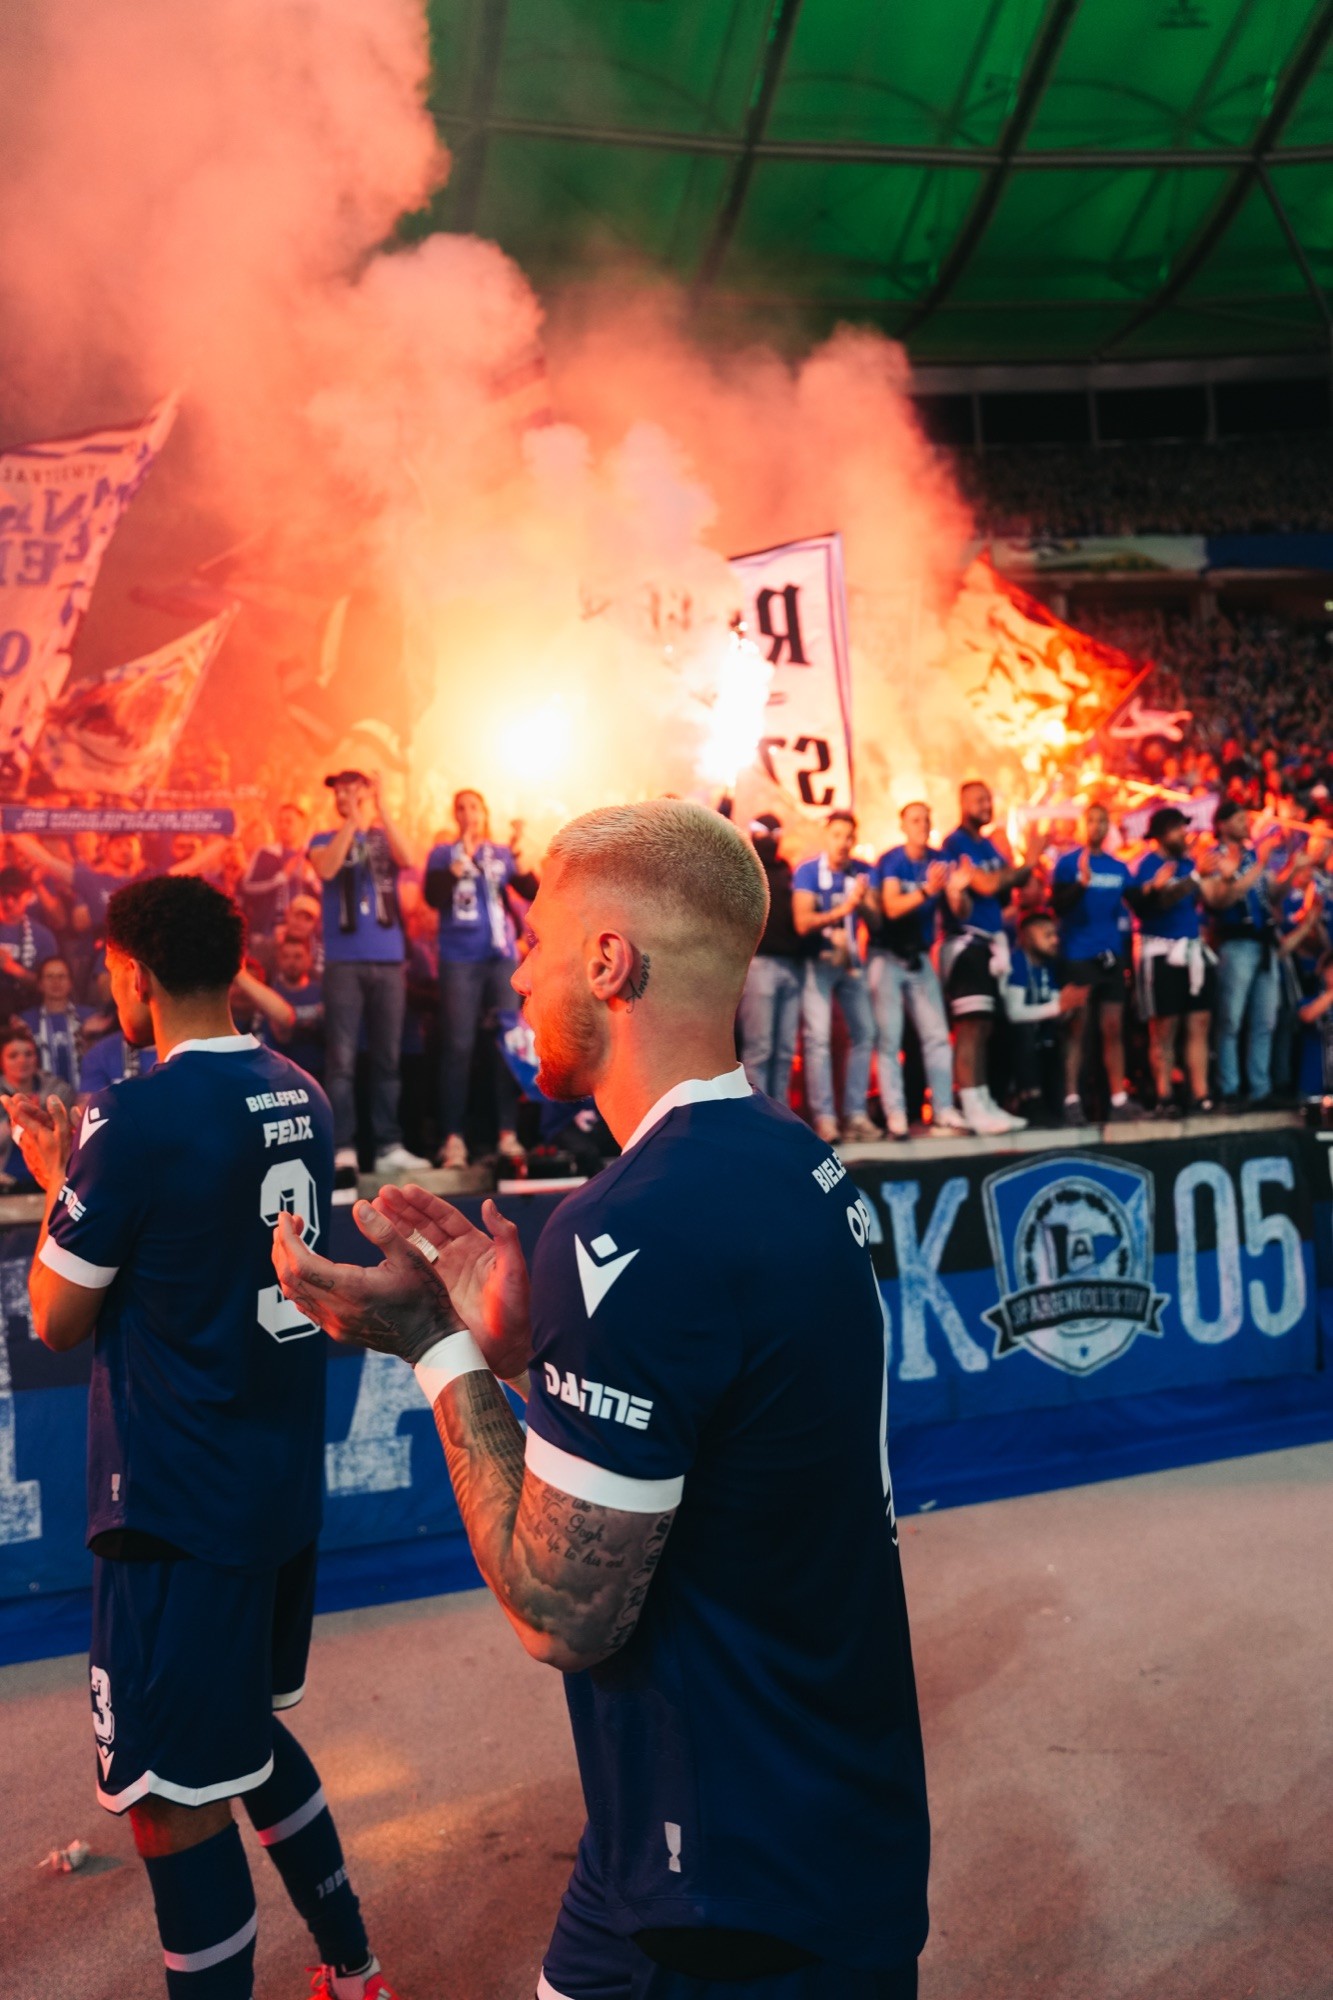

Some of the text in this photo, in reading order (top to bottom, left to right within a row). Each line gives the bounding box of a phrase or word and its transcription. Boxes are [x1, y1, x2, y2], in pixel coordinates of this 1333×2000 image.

[245, 1088, 309, 1113] BIELEFELD
[262, 1115, 314, 1148] FELIX
[1174, 1157, 1307, 1345] 05
[91, 1665, 115, 1744] 3
